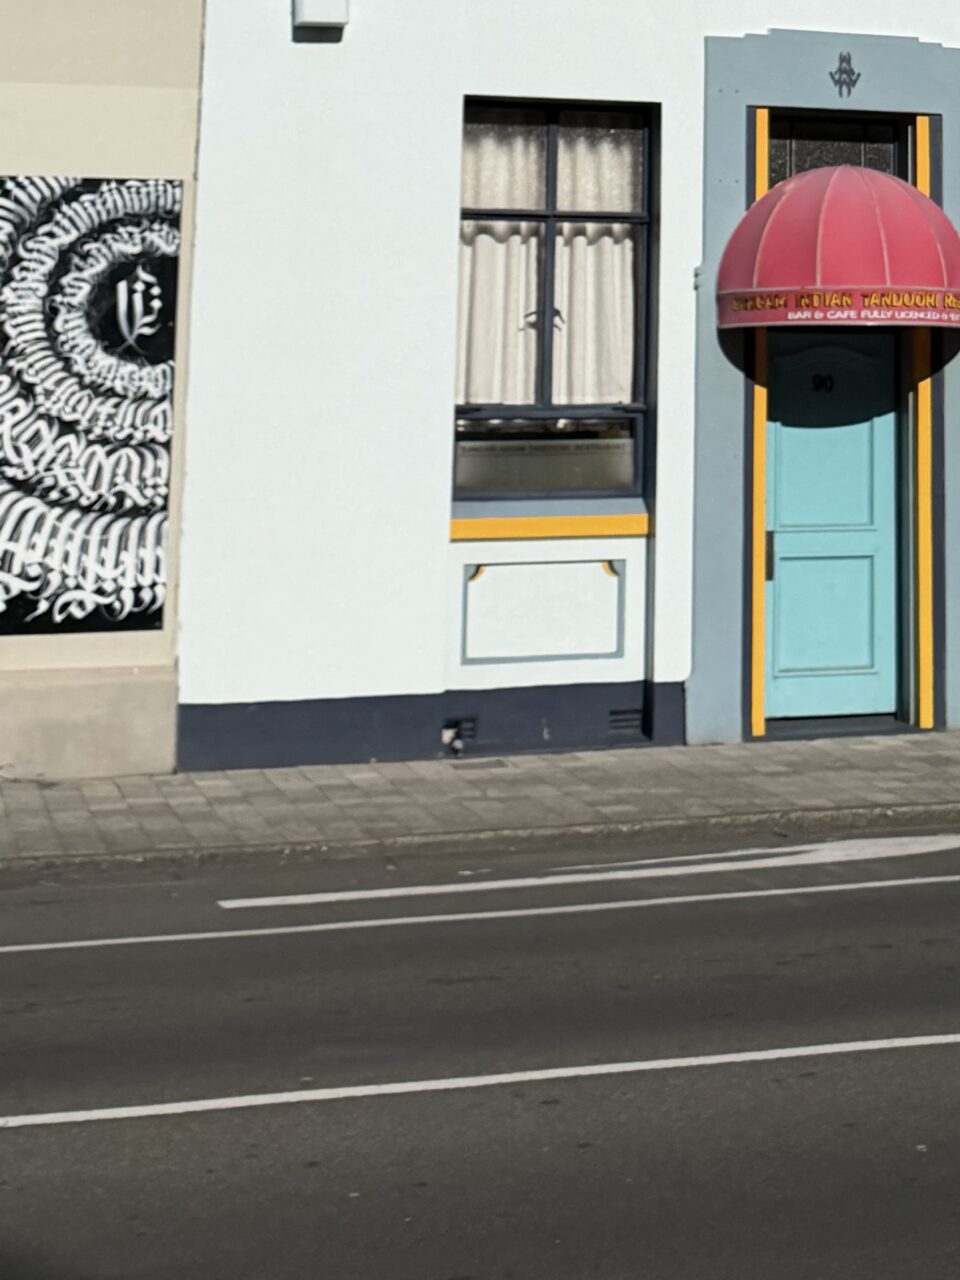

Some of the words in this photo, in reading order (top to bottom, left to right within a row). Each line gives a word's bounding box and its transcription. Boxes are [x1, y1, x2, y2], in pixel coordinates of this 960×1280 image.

[795, 290, 853, 309] INDIAN
[862, 290, 941, 309] TANDOORI
[787, 310, 812, 320] BAR
[826, 310, 858, 320] CAFE
[861, 310, 893, 319] FULLY
